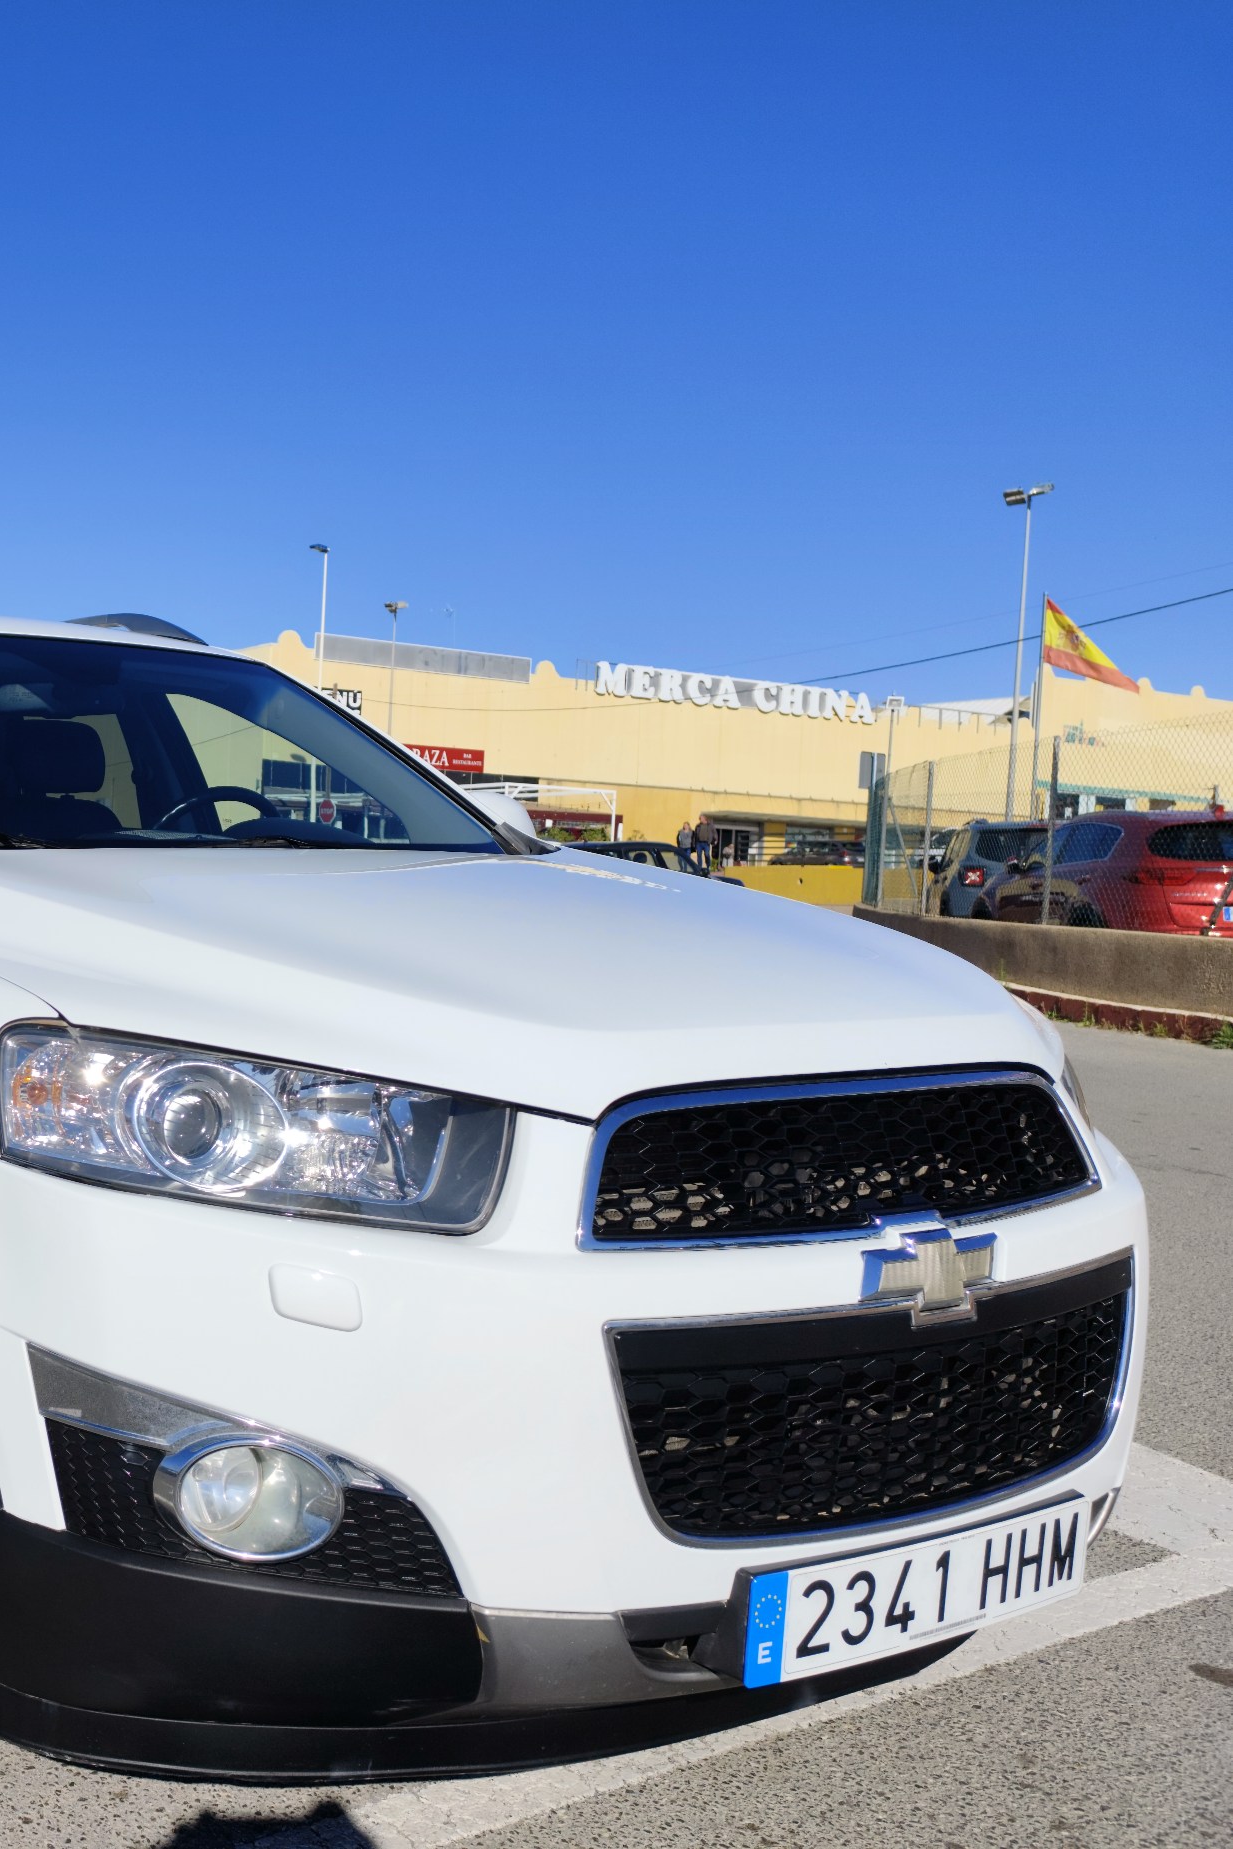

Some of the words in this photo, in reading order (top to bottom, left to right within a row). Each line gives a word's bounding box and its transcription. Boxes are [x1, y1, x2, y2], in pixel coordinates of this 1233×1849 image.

[594, 660, 742, 710] MERCA
[753, 681, 876, 725] CHINA
[794, 1548, 952, 1660] 2341
[978, 1511, 1080, 1611] HHM
[757, 1641, 773, 1665] E
